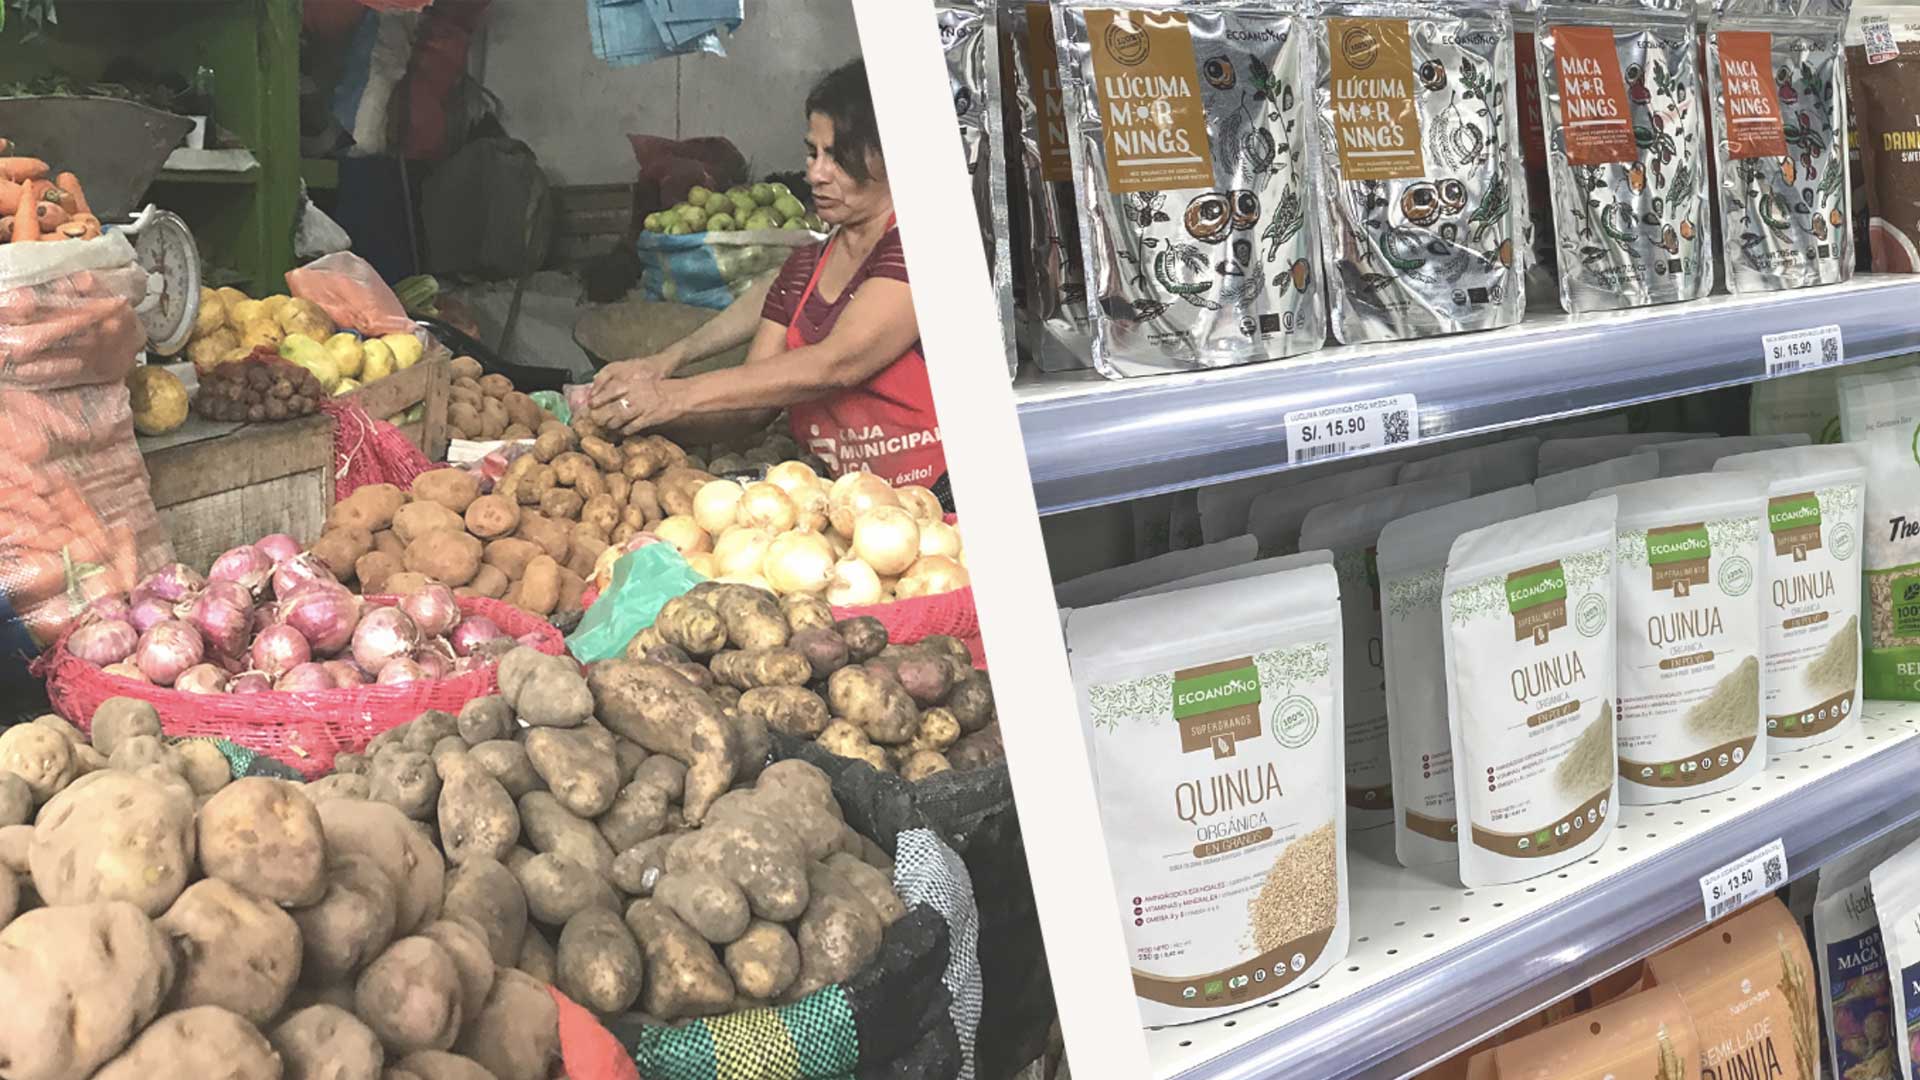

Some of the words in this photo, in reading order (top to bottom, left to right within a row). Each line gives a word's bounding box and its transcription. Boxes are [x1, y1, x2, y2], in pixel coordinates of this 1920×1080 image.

[1561, 56, 1602, 76] MACA
[1725, 60, 1758, 77] MACA
[1105, 72, 1191, 99] LÚCUMA
[1337, 75, 1406, 99] LÚCUMA
[1567, 98, 1618, 119] NINGS
[1730, 97, 1771, 116] NINGS
[1113, 128, 1190, 156] NINGS
[1342, 125, 1405, 148] NINGS
[1788, 340, 1811, 356] 15.90
[840, 425, 884, 441] CAJA
[1302, 424, 1322, 442] S/.
[1326, 416, 1365, 437] 15.90
[896, 465, 933, 485] éxito!
[1889, 516, 1920, 542] The
[1773, 570, 1835, 610] QUINUA
[1648, 606, 1723, 649] QUINUA
[1512, 650, 1586, 704] QUINUA
[1178, 680, 1256, 705] ECOANDINO
[1175, 762, 1283, 825] QUINUA
[1197, 811, 1267, 841] ORGÁNICA
[1205, 845, 1219, 856] EN
[1728, 868, 1753, 892] 13.50
[1837, 947, 1878, 970] MACA
[1700, 1028, 1754, 1068] SEMILLA
[1754, 1016, 1772, 1041] DE
